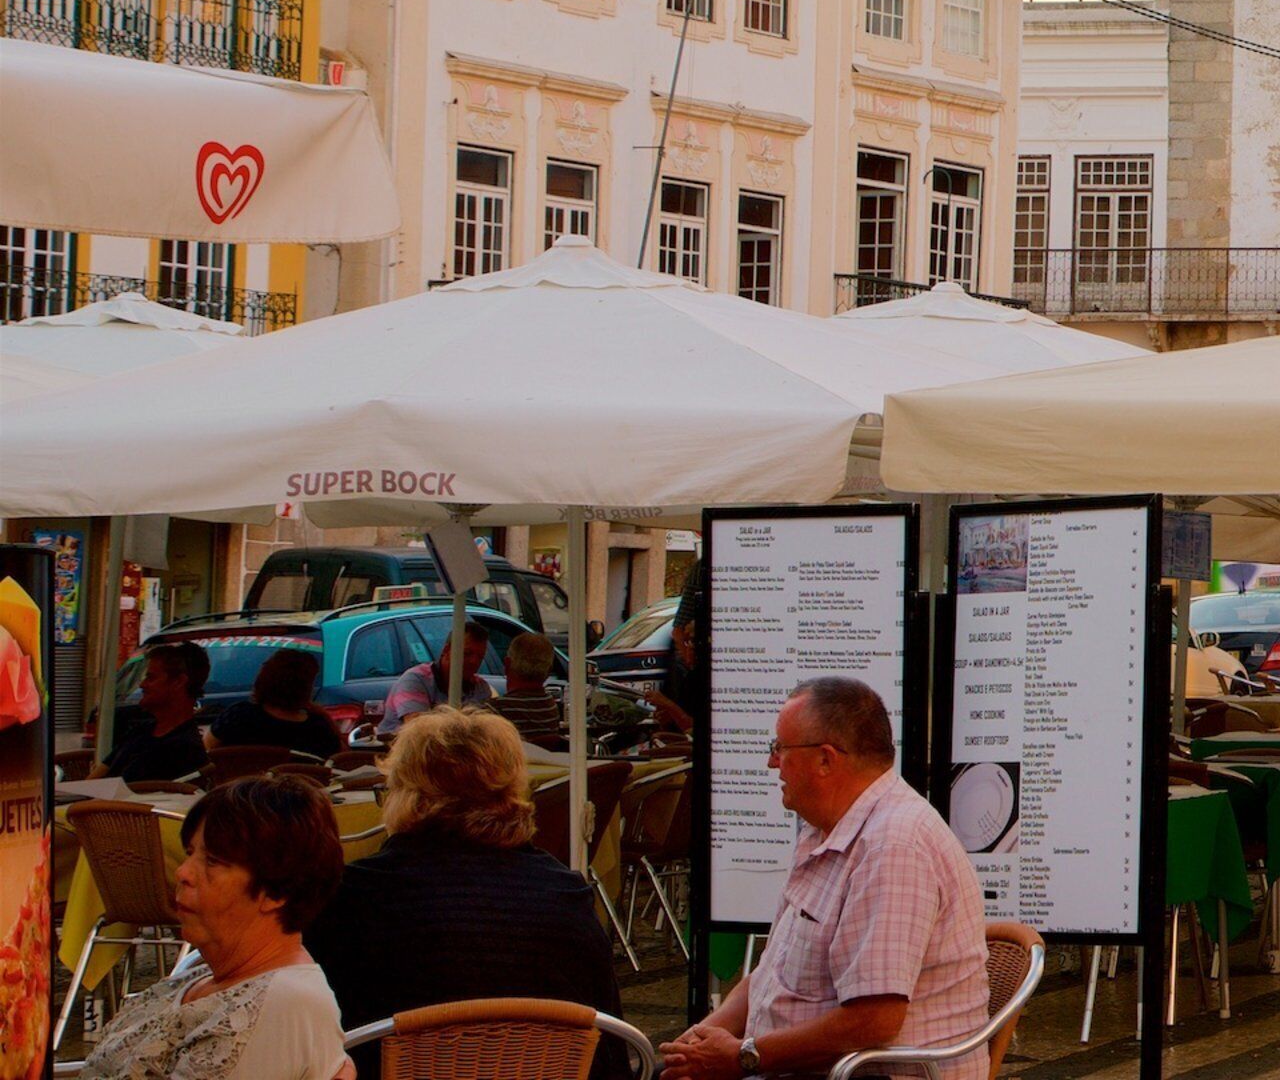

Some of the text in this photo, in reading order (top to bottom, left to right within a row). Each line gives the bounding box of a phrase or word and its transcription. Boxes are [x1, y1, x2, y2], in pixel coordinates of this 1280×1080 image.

[286, 469, 456, 497] SUPER BOCK
[220, 636, 255, 647] 277
[257, 636, 295, 648] 277
